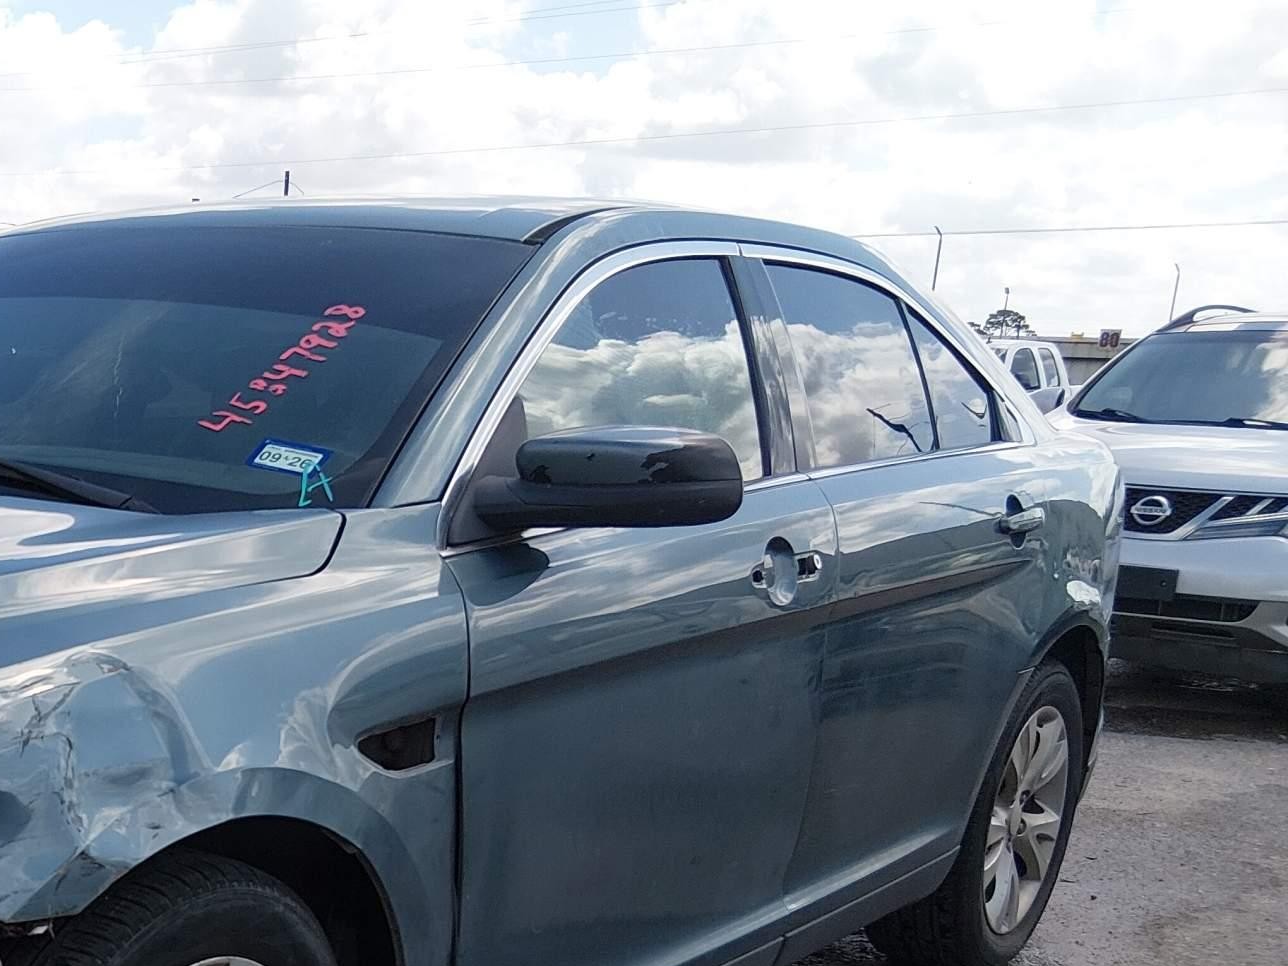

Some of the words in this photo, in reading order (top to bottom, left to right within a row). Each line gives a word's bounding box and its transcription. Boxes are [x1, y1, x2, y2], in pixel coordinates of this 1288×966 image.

[1099, 331, 1120, 348] 80
[196, 304, 366, 432] 45847928
[258, 451, 282, 463] 09
